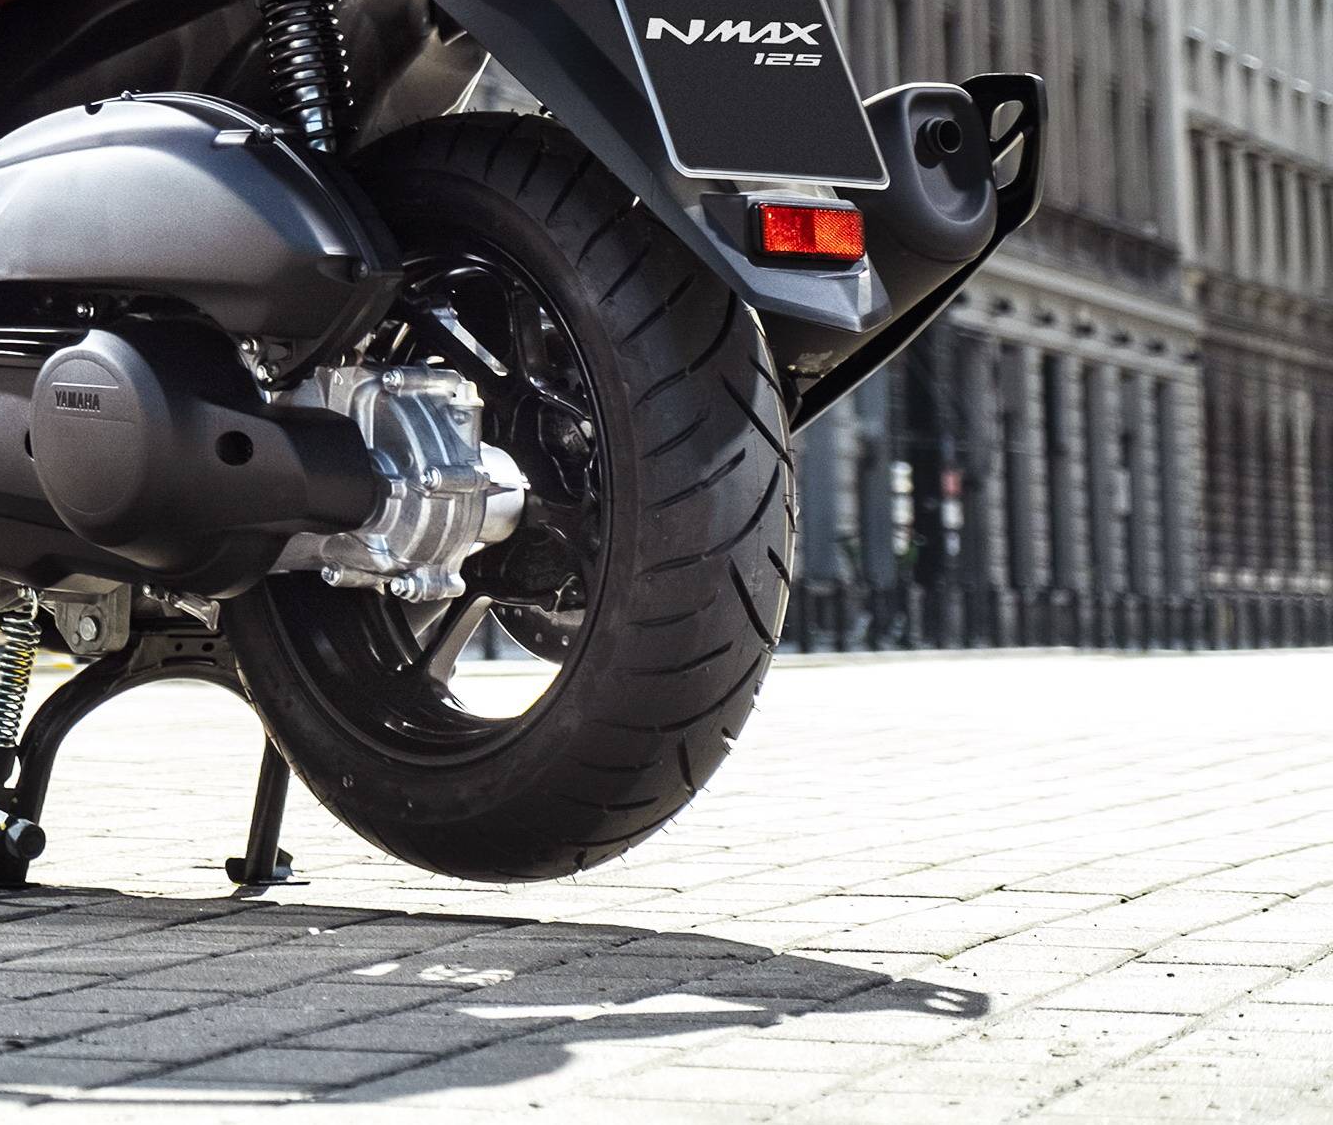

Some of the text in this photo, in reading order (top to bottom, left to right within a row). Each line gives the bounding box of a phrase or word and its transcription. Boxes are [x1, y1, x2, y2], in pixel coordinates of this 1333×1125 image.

[645, 17, 823, 45] NMAX
[753, 52, 823, 67] 125
[55, 390, 100, 411] YAMAHA
